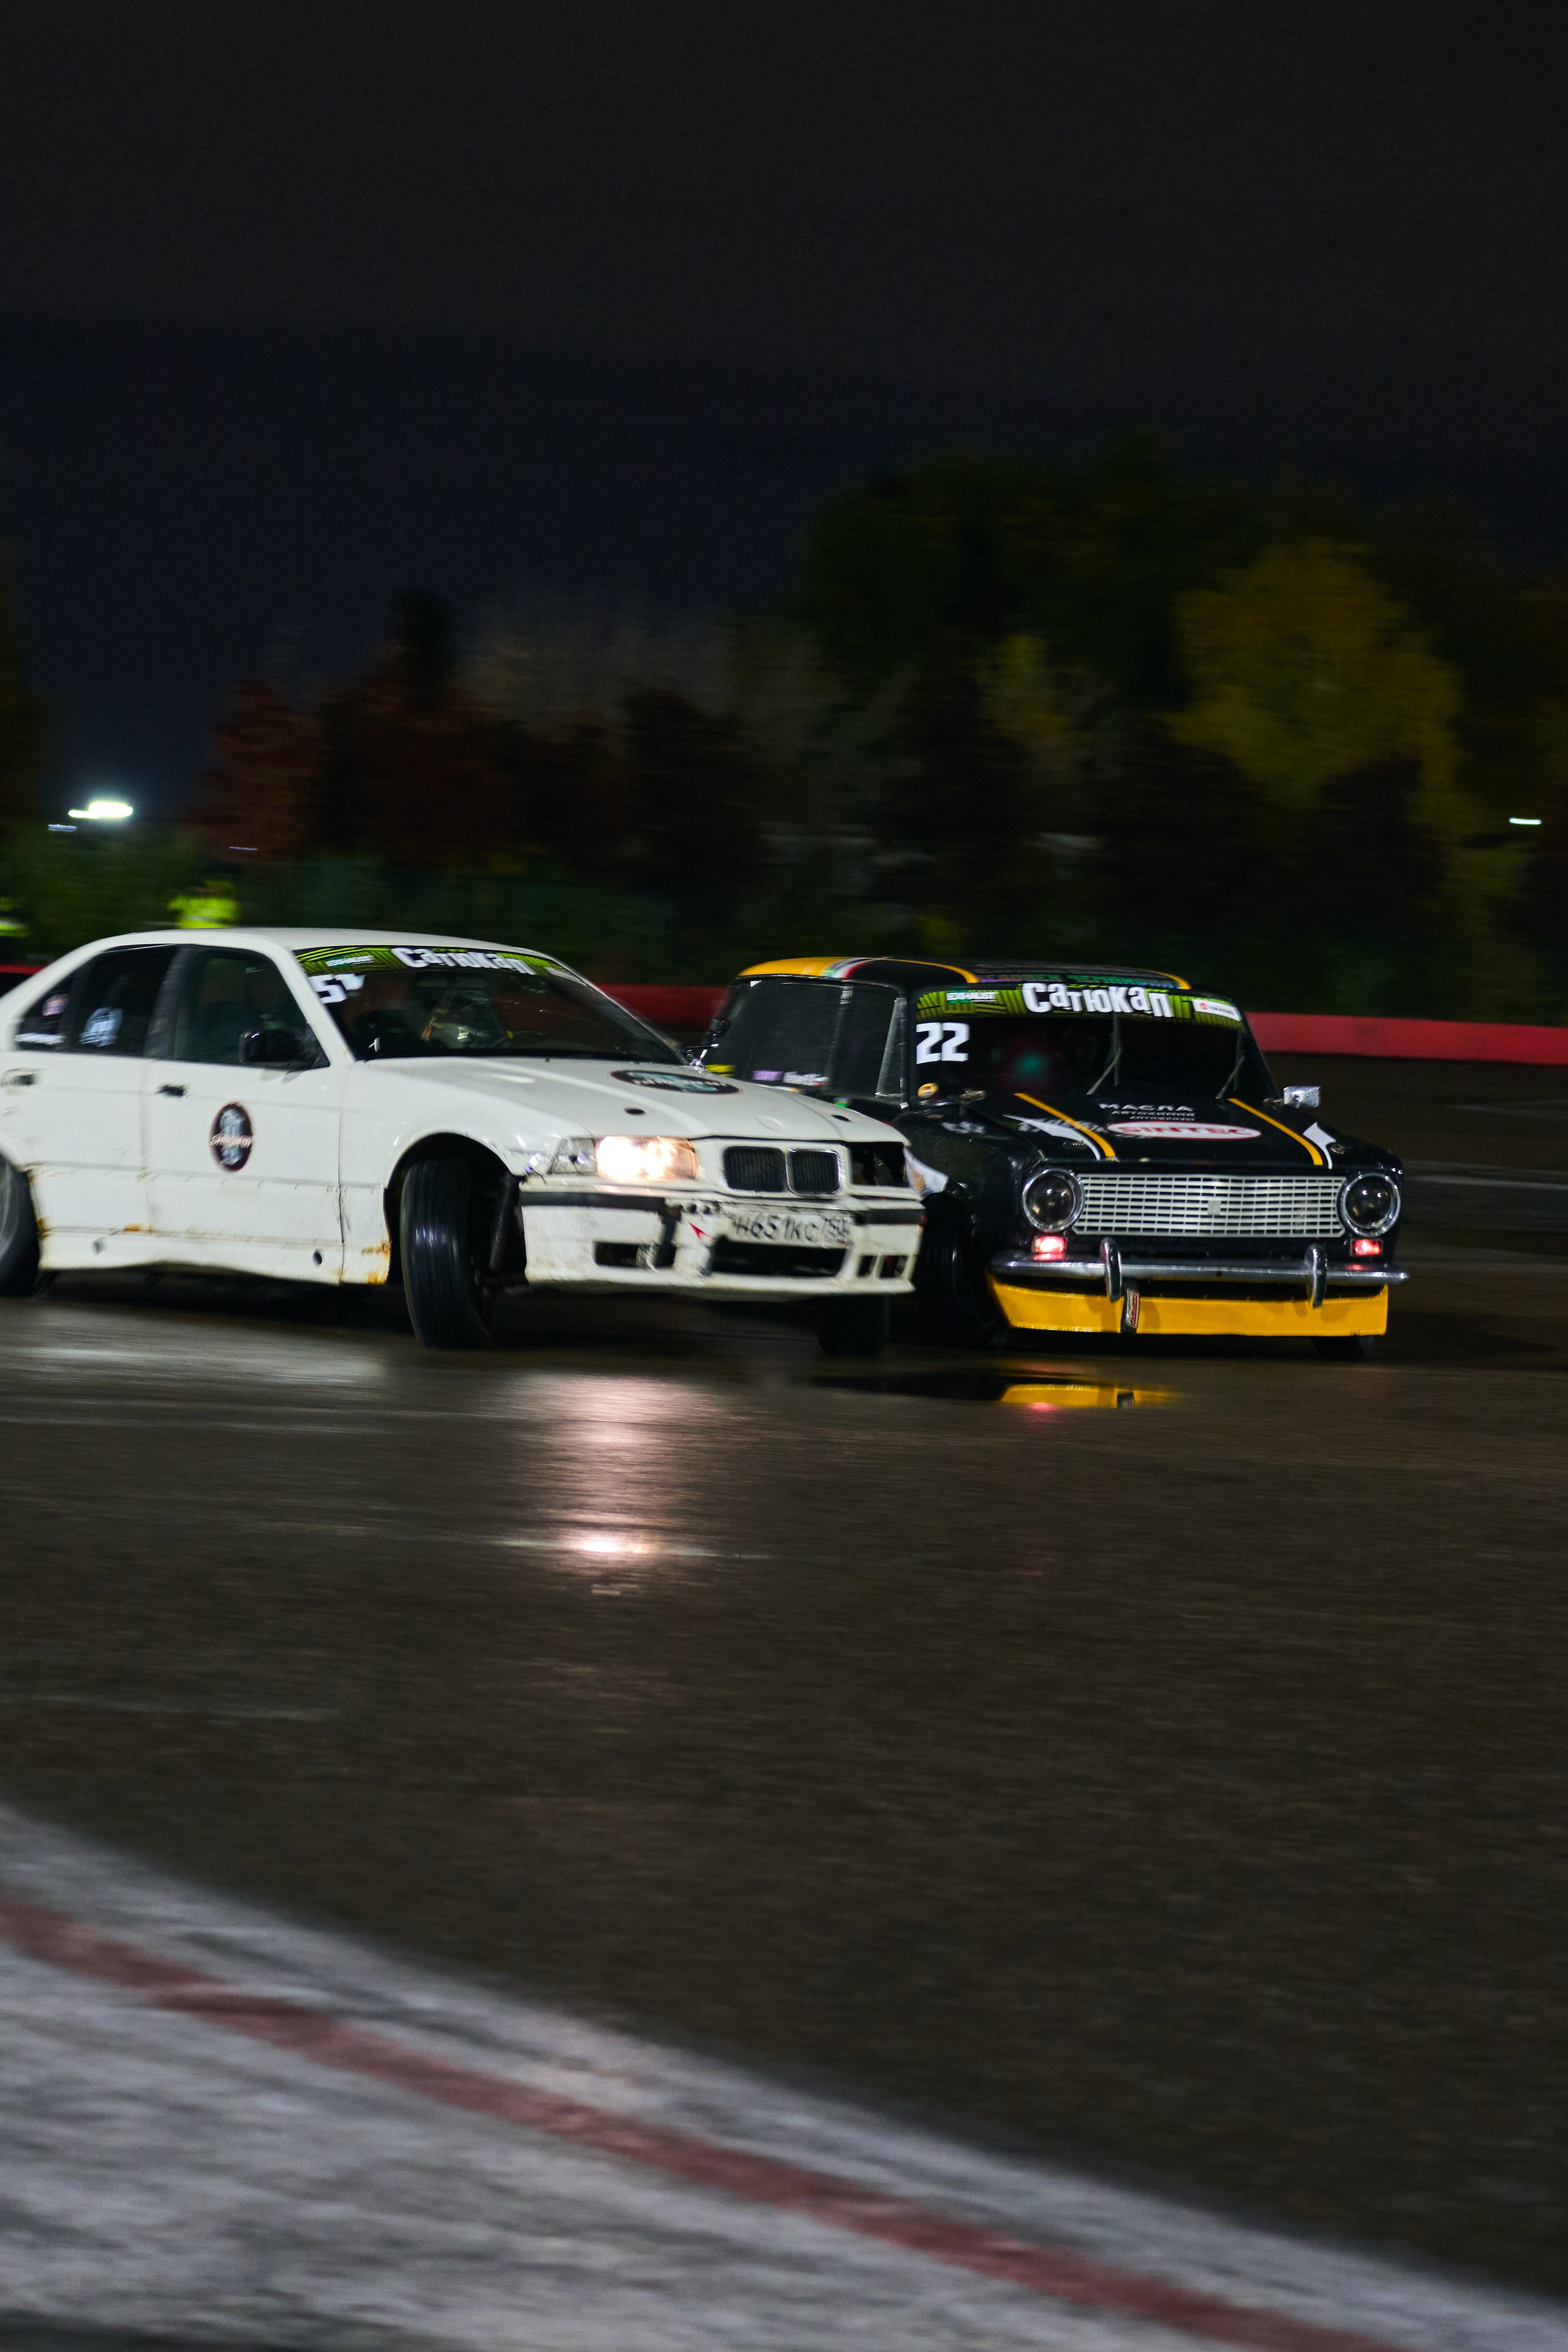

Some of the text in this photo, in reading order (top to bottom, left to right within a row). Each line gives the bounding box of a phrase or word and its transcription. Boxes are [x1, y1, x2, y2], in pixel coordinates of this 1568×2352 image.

[946, 992, 998, 1001] EXHAUST
[916, 1022, 970, 1065] 22
[1099, 1103, 1194, 1112] МАСЛА
[1117, 1127, 1253, 1136] SINTEC
